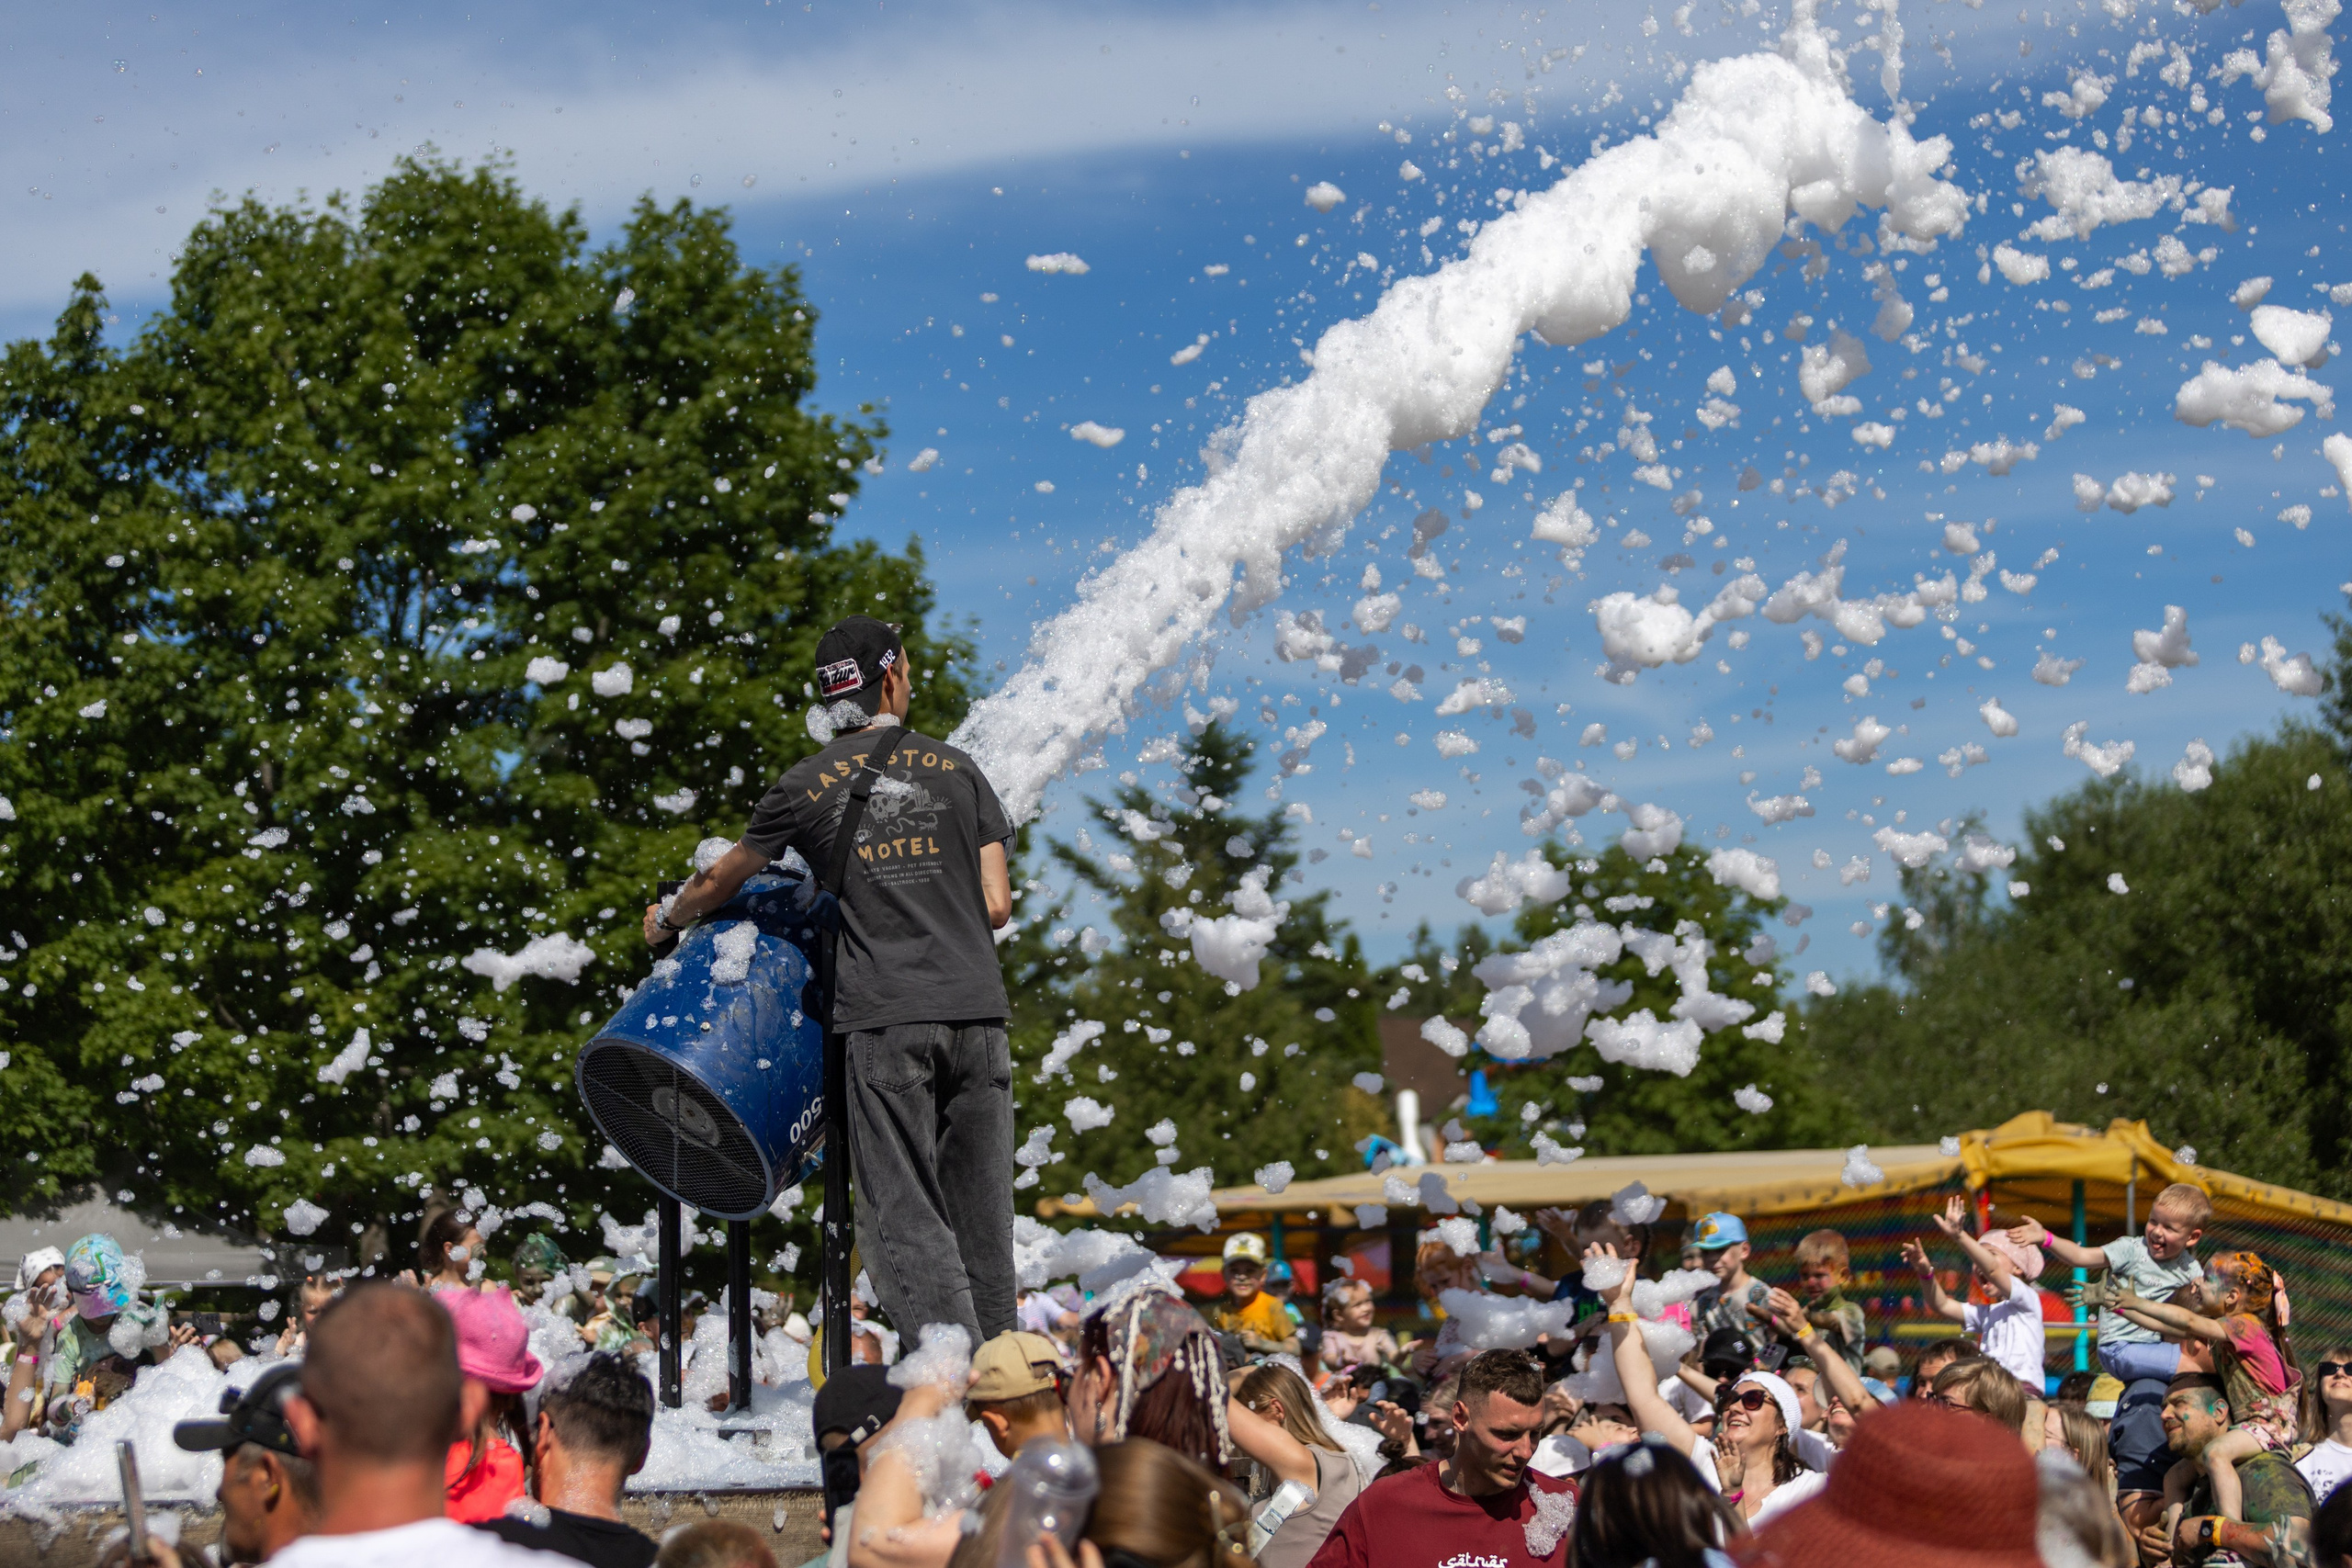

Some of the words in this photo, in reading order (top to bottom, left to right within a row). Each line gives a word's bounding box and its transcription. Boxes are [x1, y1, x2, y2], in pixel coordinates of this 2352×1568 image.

[879, 649, 897, 670] 1932
[807, 753, 870, 803] LAST
[887, 749, 956, 773] STOP
[857, 837, 940, 863] MOTEL
